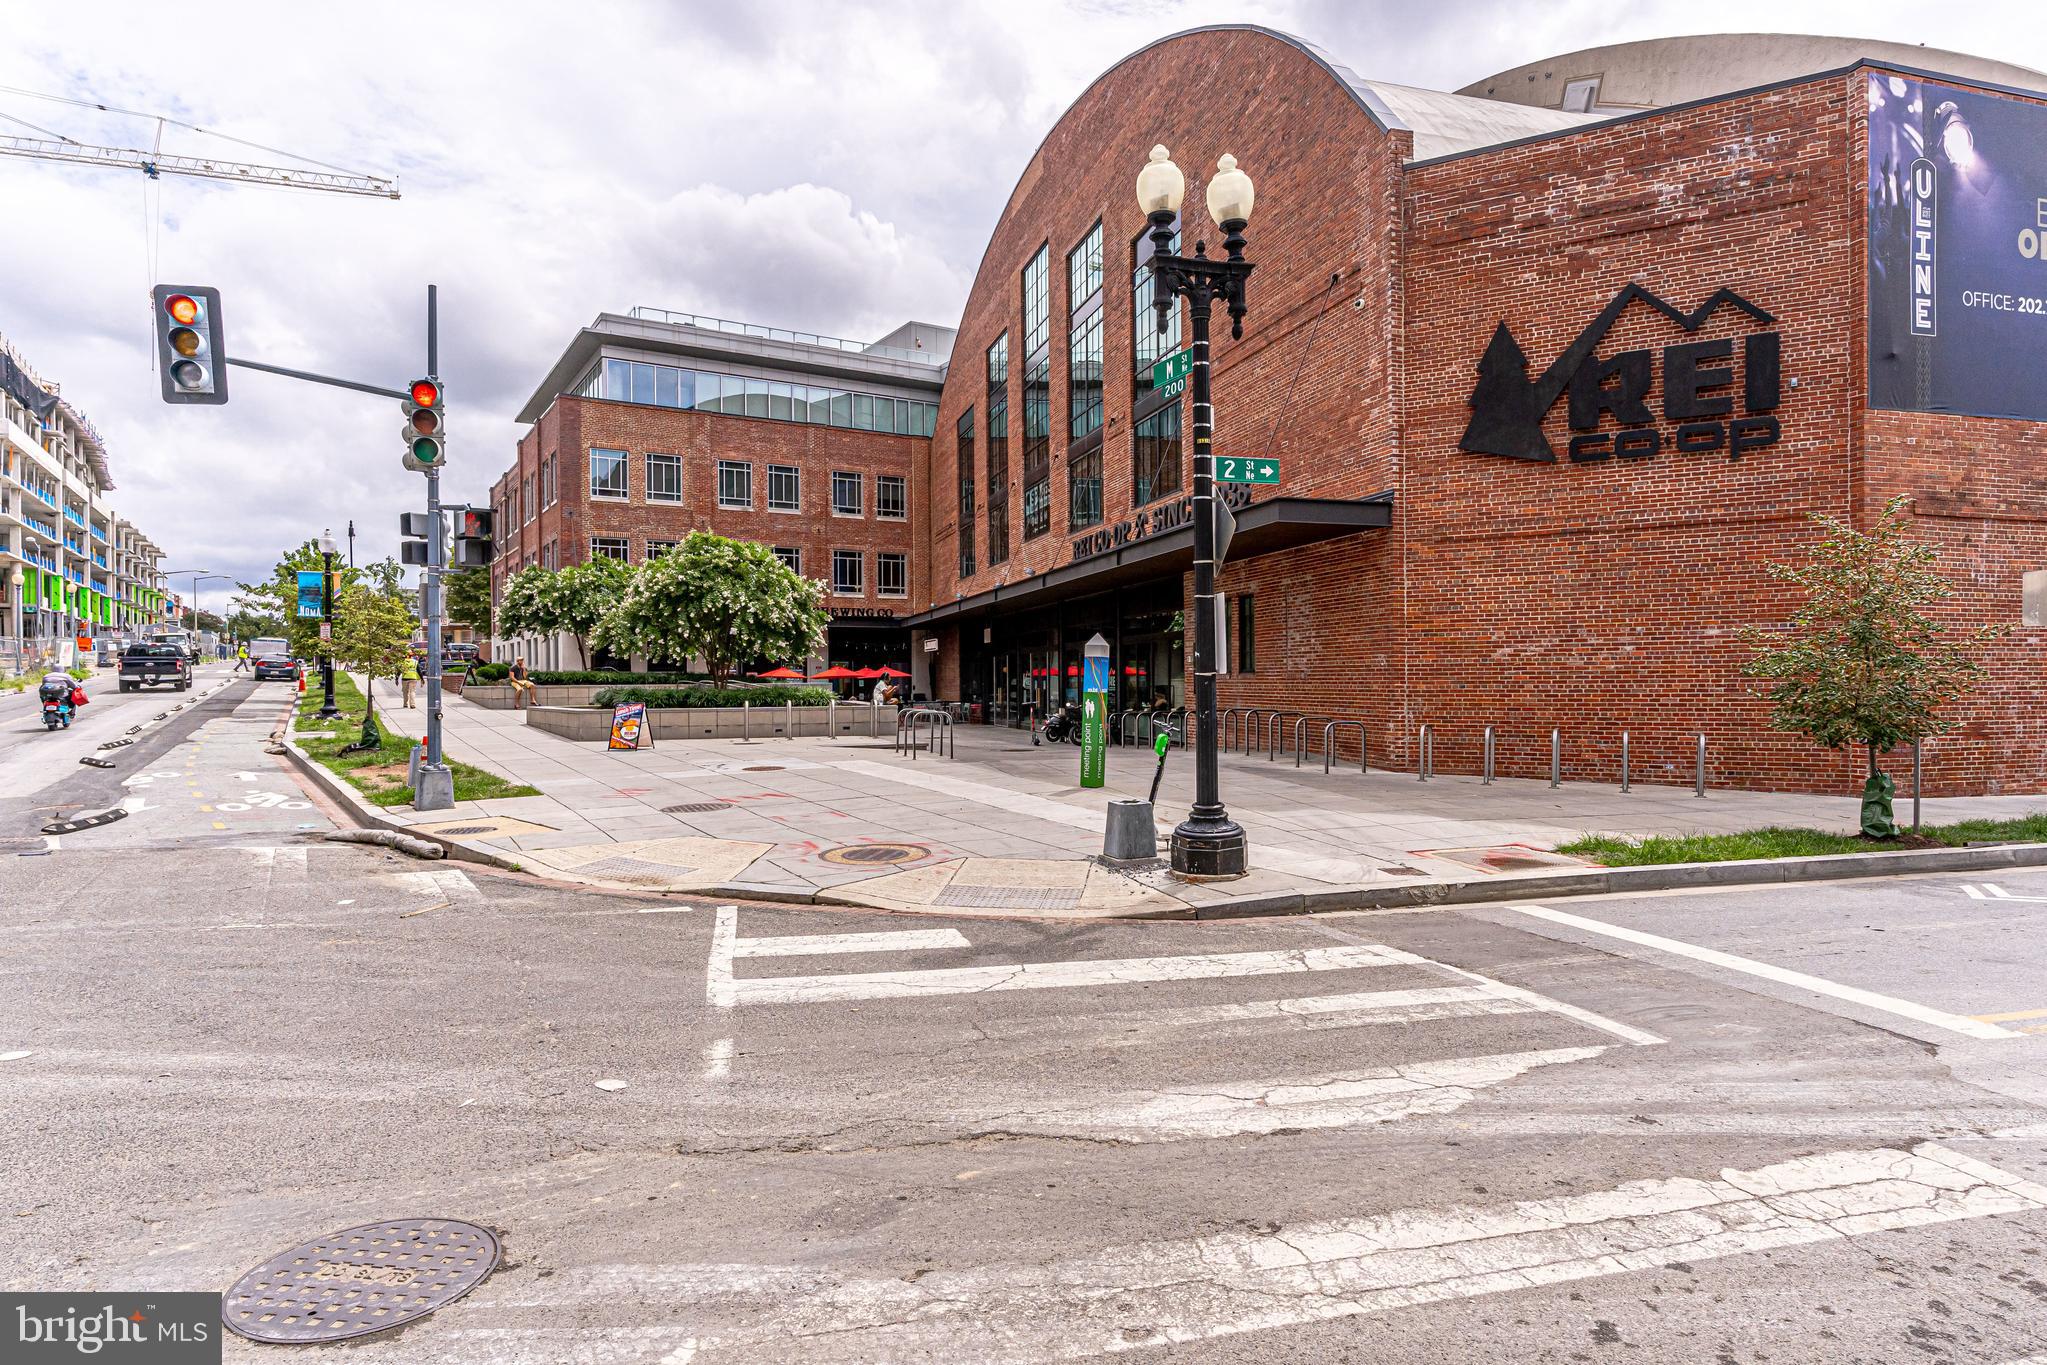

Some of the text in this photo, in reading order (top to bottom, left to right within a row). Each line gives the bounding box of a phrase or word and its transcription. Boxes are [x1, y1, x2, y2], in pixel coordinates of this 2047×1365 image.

[1915, 168, 1932, 329] ULINE
[1962, 290, 2047, 314] OFFICE: 202.
[1166, 360, 1174, 380] M
[1568, 332, 1780, 430] REI
[1165, 379, 1184, 398] 200
[1224, 460, 1255, 479] 2 St
[1084, 723, 1092, 778] meeting point
